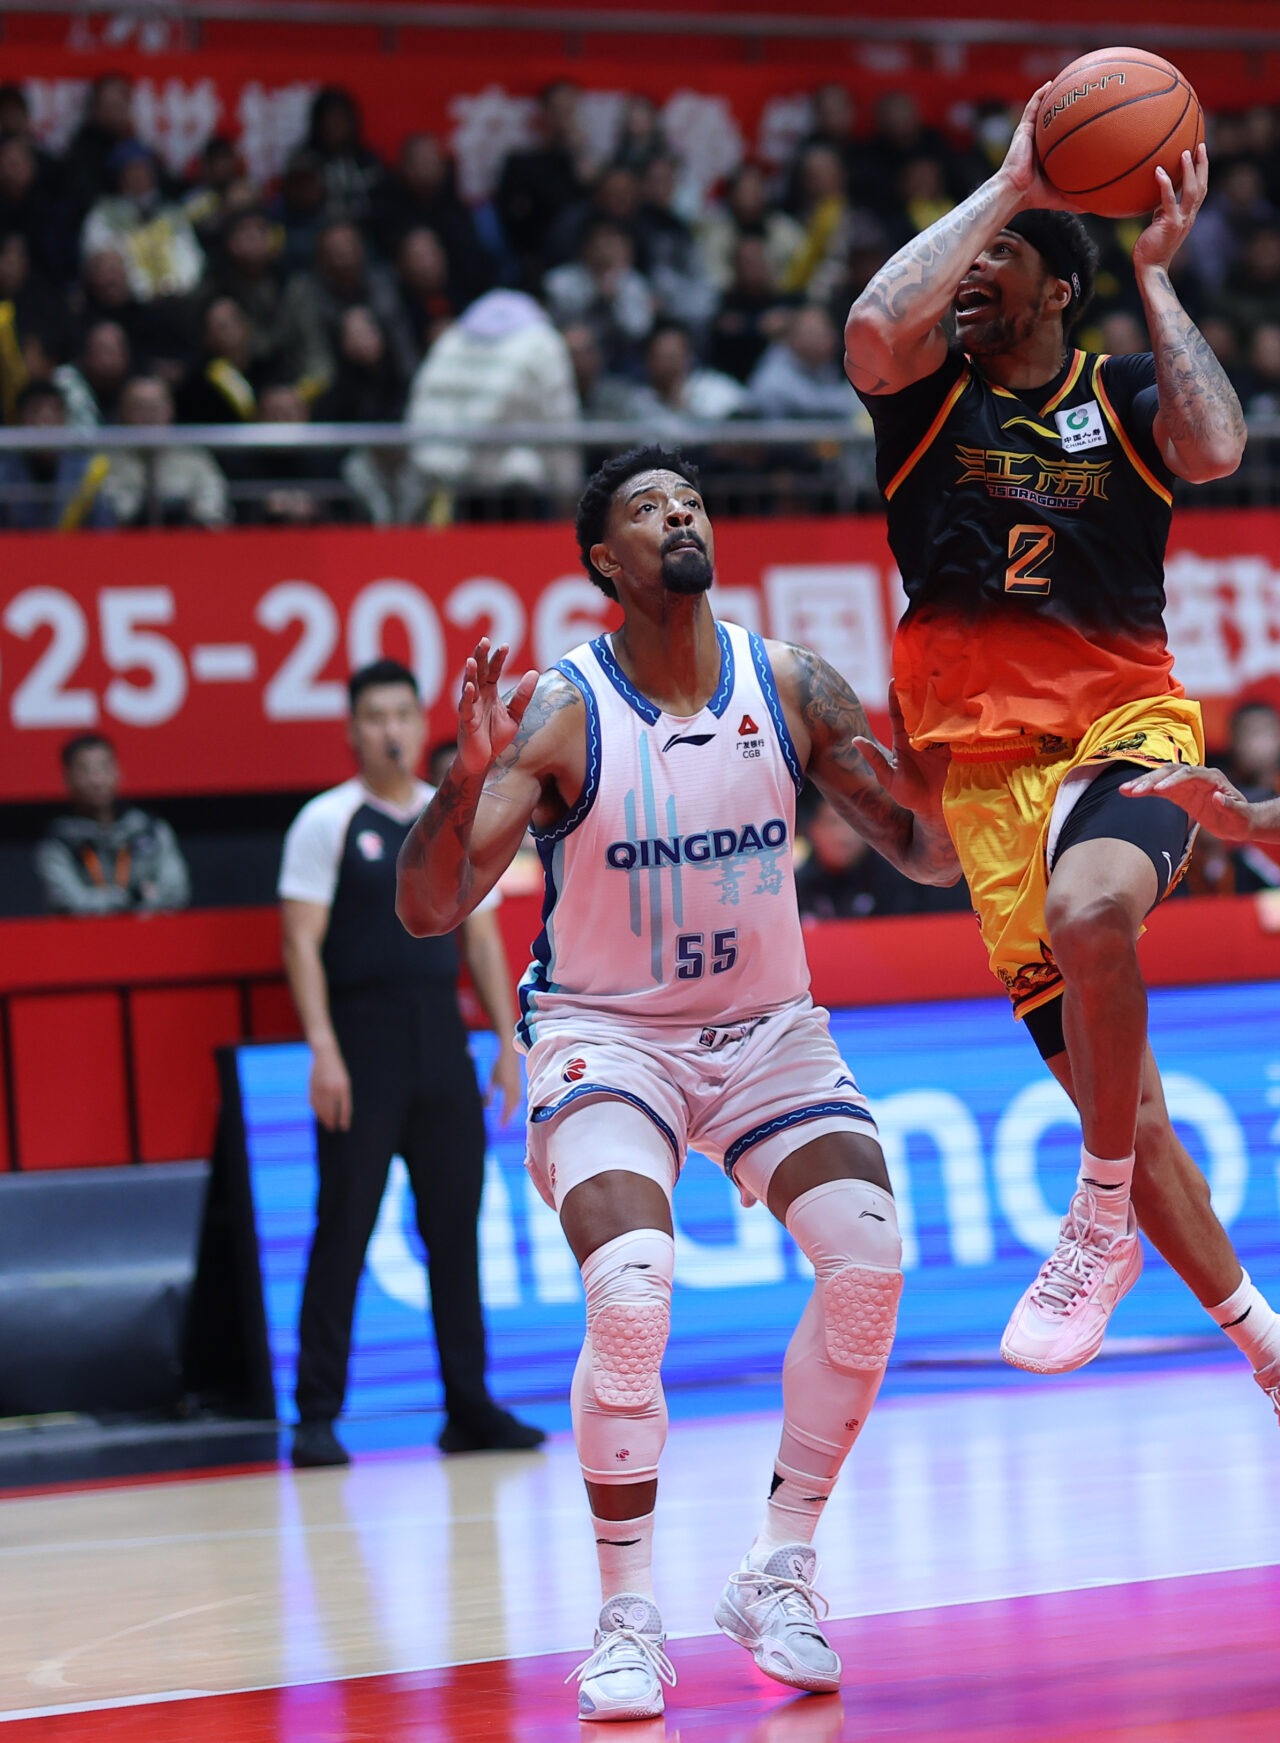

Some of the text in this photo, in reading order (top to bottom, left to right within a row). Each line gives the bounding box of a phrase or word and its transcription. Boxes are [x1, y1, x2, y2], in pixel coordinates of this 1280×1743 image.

[1043, 72, 1127, 128] LI-NING
[1064, 428, 1101, 443] 中国人寿
[1065, 436, 1103, 449] CHINA LIFE
[1008, 487, 1081, 508] DRAGONS
[1005, 524, 1056, 596] 2
[742, 749, 761, 759] CGB
[606, 818, 788, 870] QINGDAO
[675, 928, 739, 982] 55
